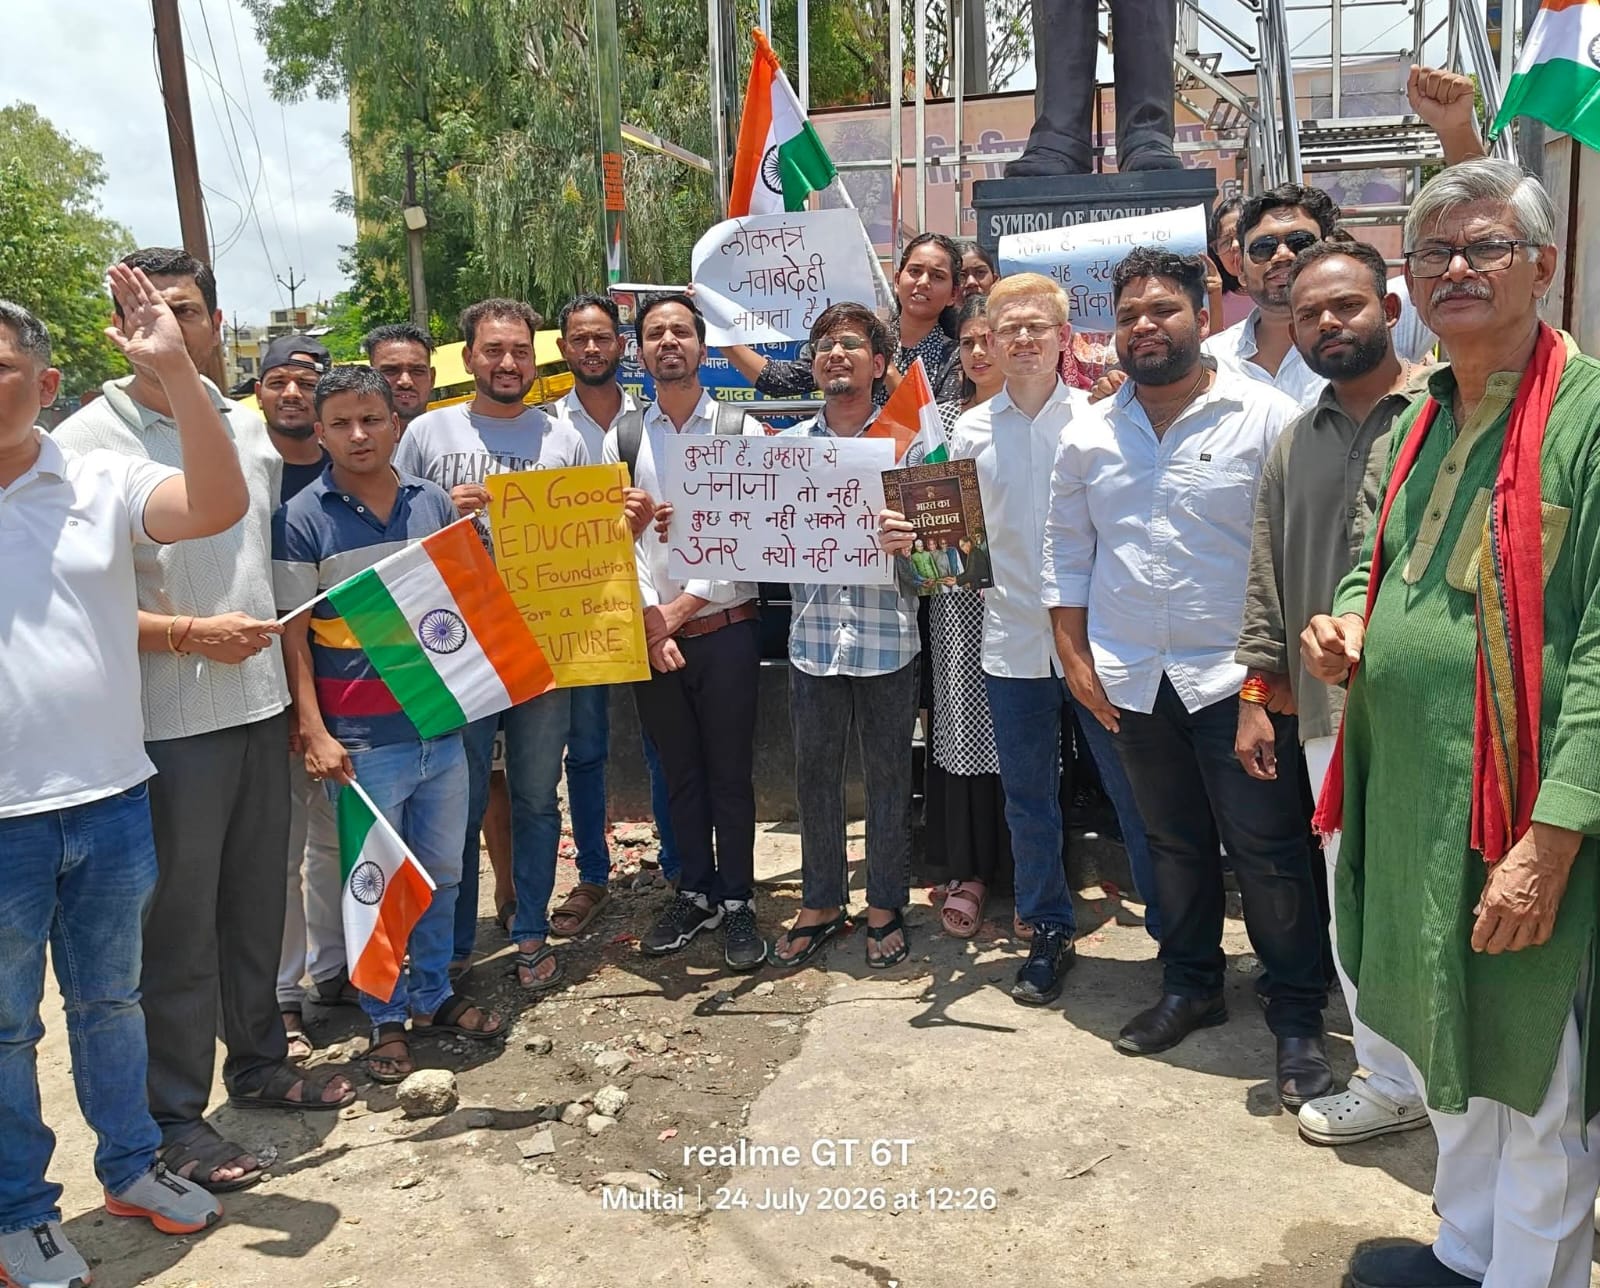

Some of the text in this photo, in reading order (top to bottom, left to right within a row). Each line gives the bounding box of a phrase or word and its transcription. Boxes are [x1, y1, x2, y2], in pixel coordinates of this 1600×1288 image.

[721, 220, 806, 256] लोकतंत्र
[728, 253, 825, 300] जवाबदेही
[1050, 262, 1072, 284] यह
[733, 307, 792, 331] मांगता
[715, 386, 756, 401] यादव
[685, 440, 840, 472] कुर्सी है, तुम्हारा ये
[501, 468, 624, 518] A Good
[683, 472, 780, 501] जनाज़ा
[797, 477, 819, 502] तो
[692, 504, 877, 532] कुछ कर नही सकते तो
[916, 499, 950, 511] भारत का
[672, 535, 746, 571] उतर
[761, 534, 796, 568] क्यो
[802, 538, 840, 572] नही
[501, 559, 635, 593] IS Foundation
[559, 608, 573, 617] a
